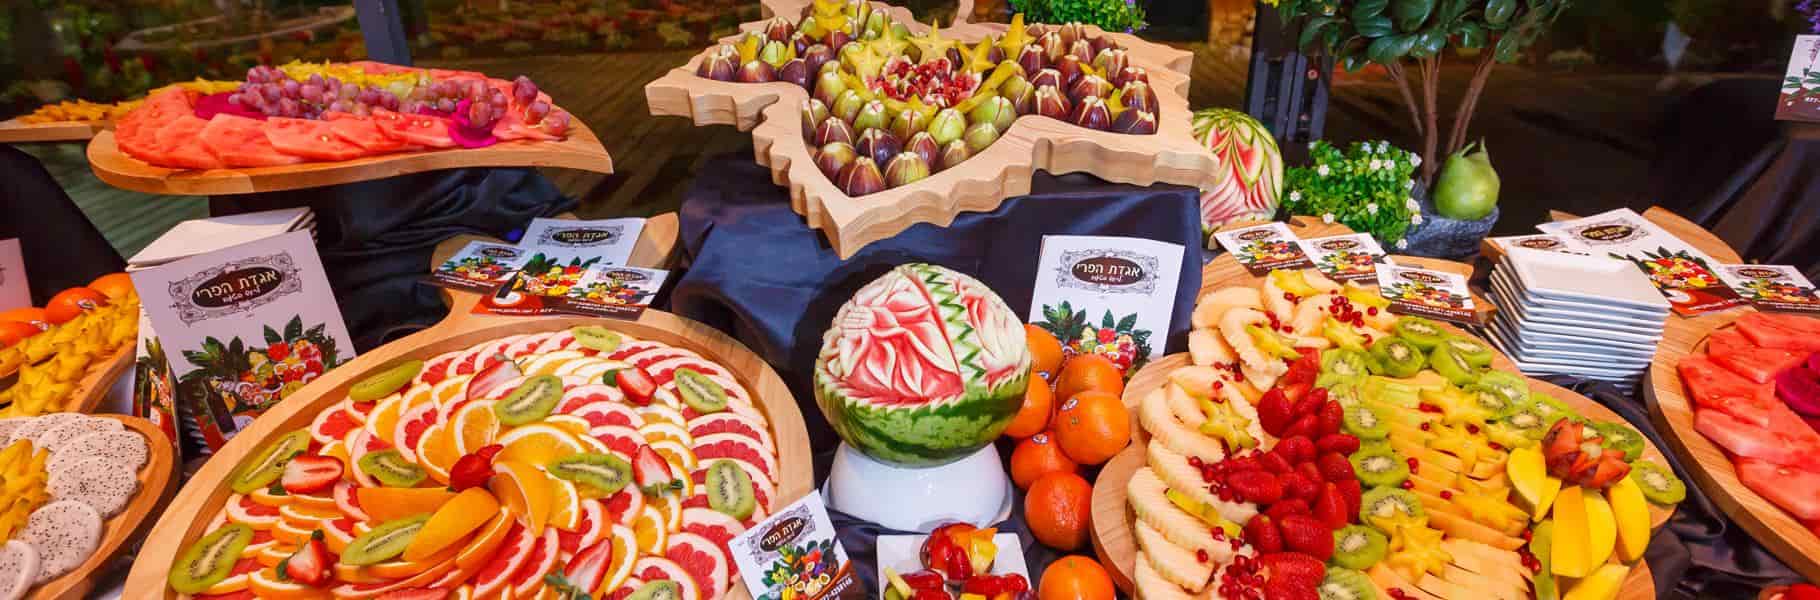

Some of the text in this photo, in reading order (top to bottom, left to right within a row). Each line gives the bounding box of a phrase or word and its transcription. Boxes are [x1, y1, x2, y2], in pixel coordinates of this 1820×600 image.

[1076, 263, 1140, 277] אגדת הפרי
[240, 270, 277, 290] אגדת
[196, 282, 234, 298] הפרי
